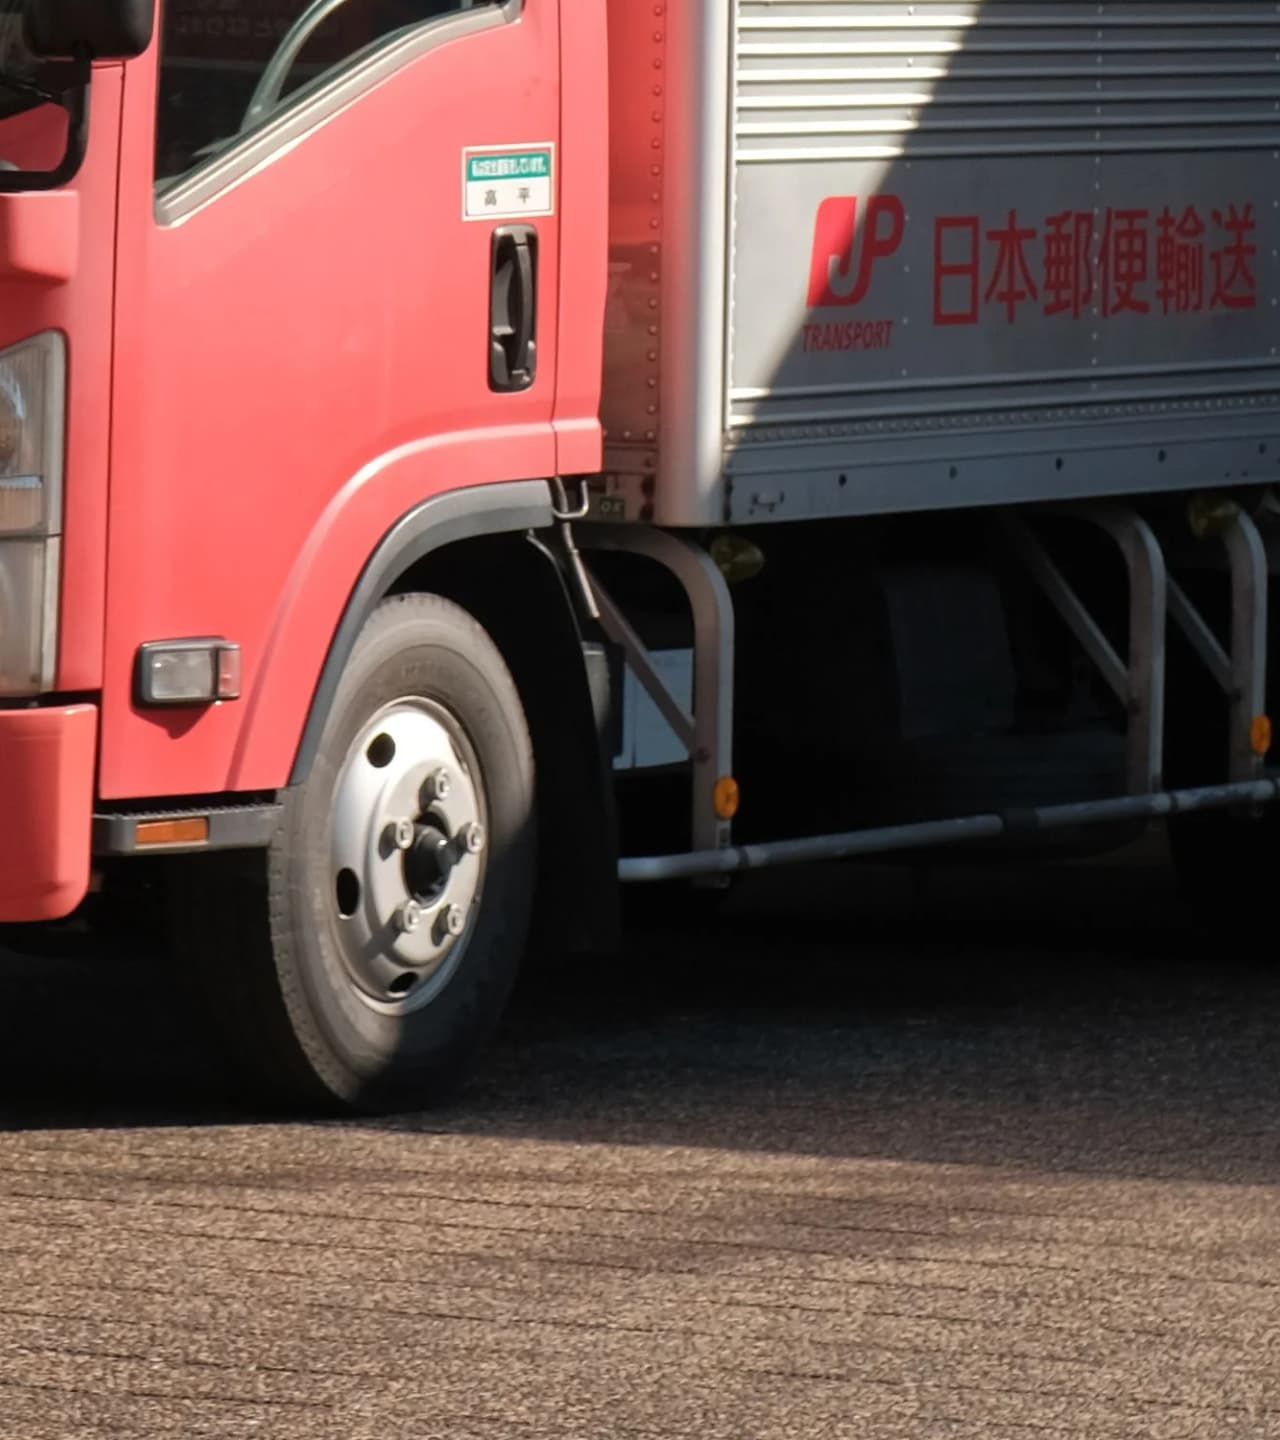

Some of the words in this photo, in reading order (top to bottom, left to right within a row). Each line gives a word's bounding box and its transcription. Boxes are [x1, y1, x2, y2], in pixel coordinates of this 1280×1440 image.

[933, 203, 1257, 326] 日本郵便輸送
[802, 320, 893, 352] TRANSPORT
